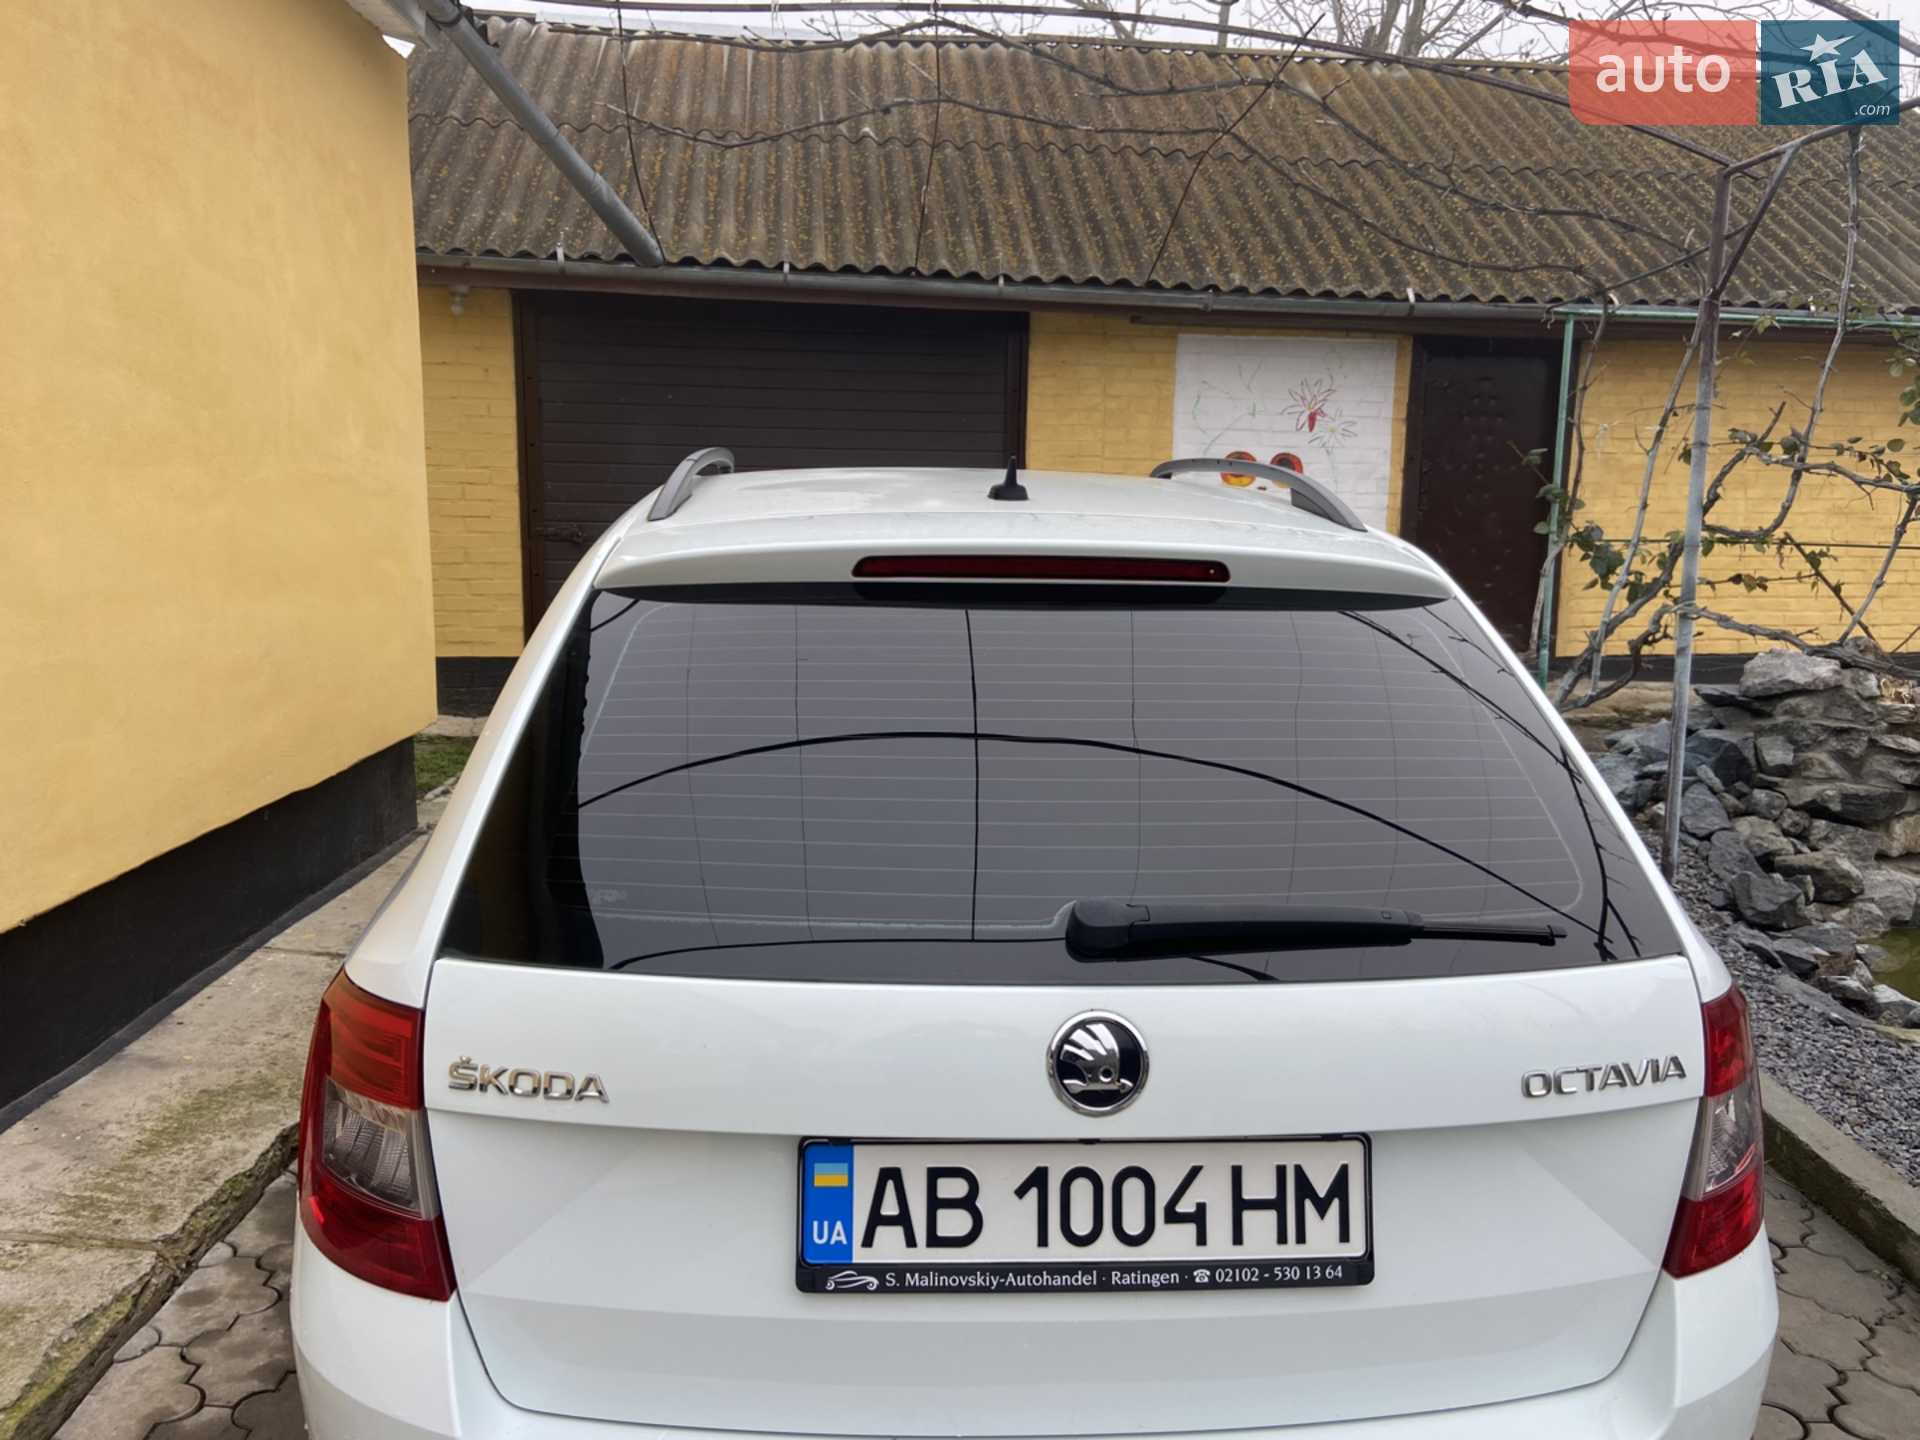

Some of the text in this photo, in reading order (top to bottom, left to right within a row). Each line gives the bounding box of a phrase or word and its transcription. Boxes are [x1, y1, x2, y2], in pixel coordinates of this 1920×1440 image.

[448, 1055, 609, 1103] ŠKODA
[1521, 1054, 1686, 1098] OCTAVIA
[861, 1163, 1350, 1248] AB 1004 HM
[812, 1220, 848, 1245] UA
[885, 1272, 900, 1287] S.
[905, 1270, 1097, 1290] Malinovskiy-Autohandel
[1111, 1269, 1180, 1287] Ratingen
[1215, 1267, 1259, 1283] 02102
[1273, 1266, 1300, 1281] 530
[1305, 1265, 1321, 1280] 13
[1325, 1264, 1343, 1279] 64
